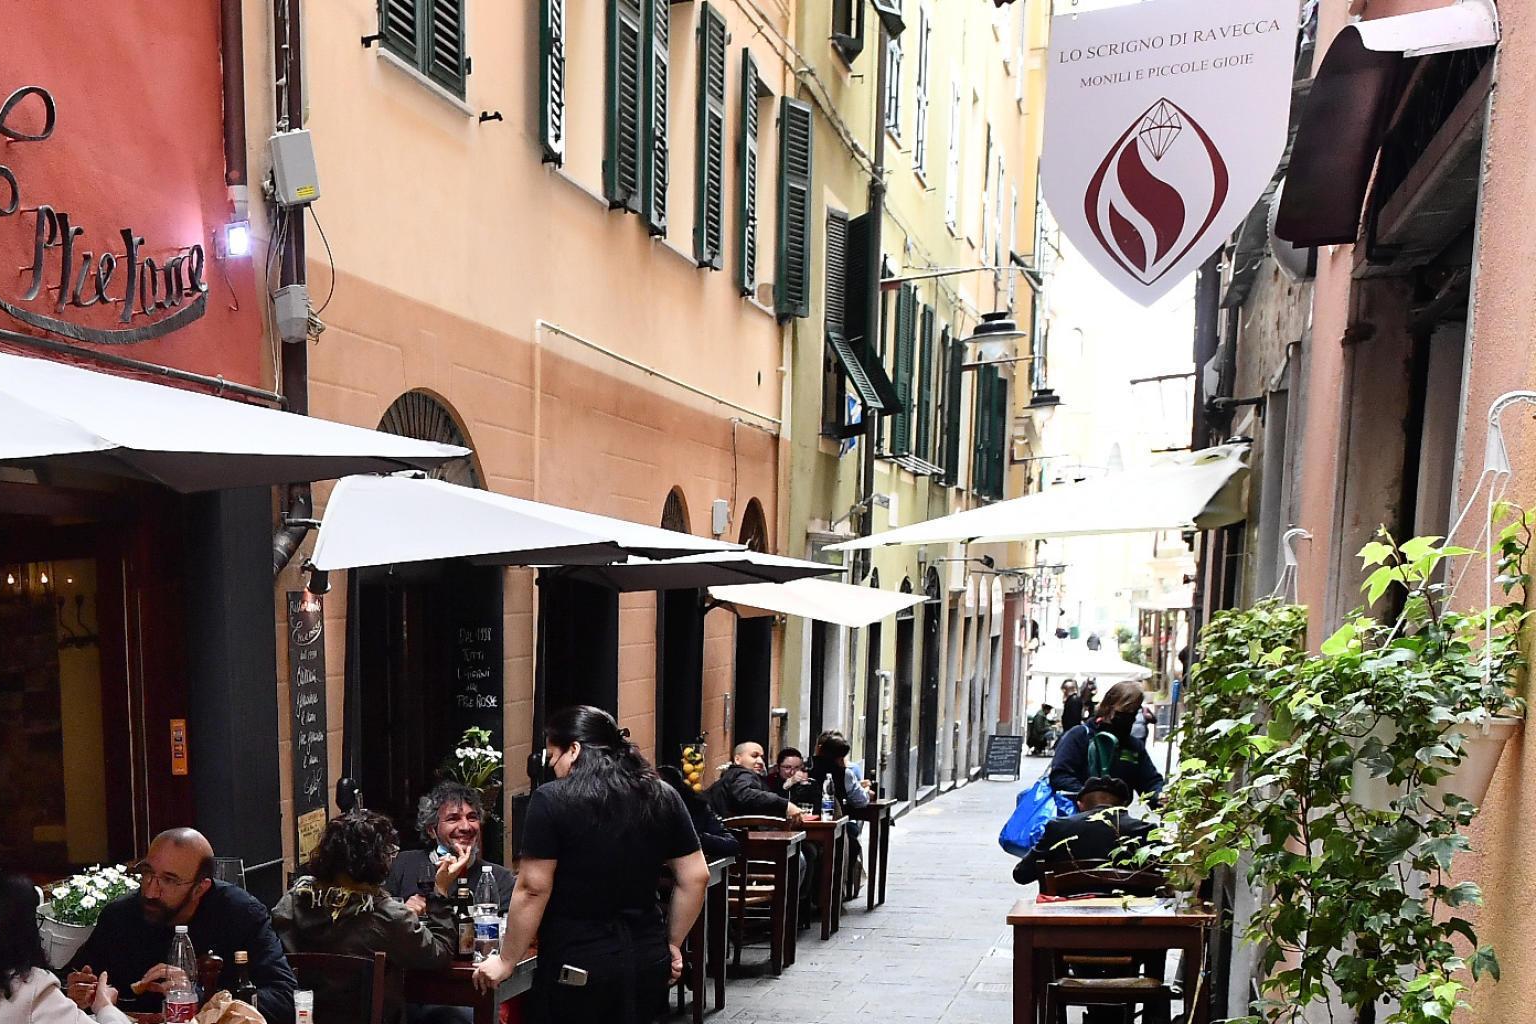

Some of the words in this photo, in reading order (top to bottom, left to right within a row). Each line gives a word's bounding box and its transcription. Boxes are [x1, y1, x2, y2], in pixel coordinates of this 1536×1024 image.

[1059, 49, 1082, 64] LO
[1086, 35, 1164, 59] SCRIGNO
[1169, 32, 1187, 47] DI
[1193, 19, 1280, 43] RAVECCA
[1080, 71, 1131, 88] MONILI
[1135, 68, 1144, 80] E
[1148, 58, 1209, 78] PICCOLE
[1213, 52, 1254, 69] GIOIE
